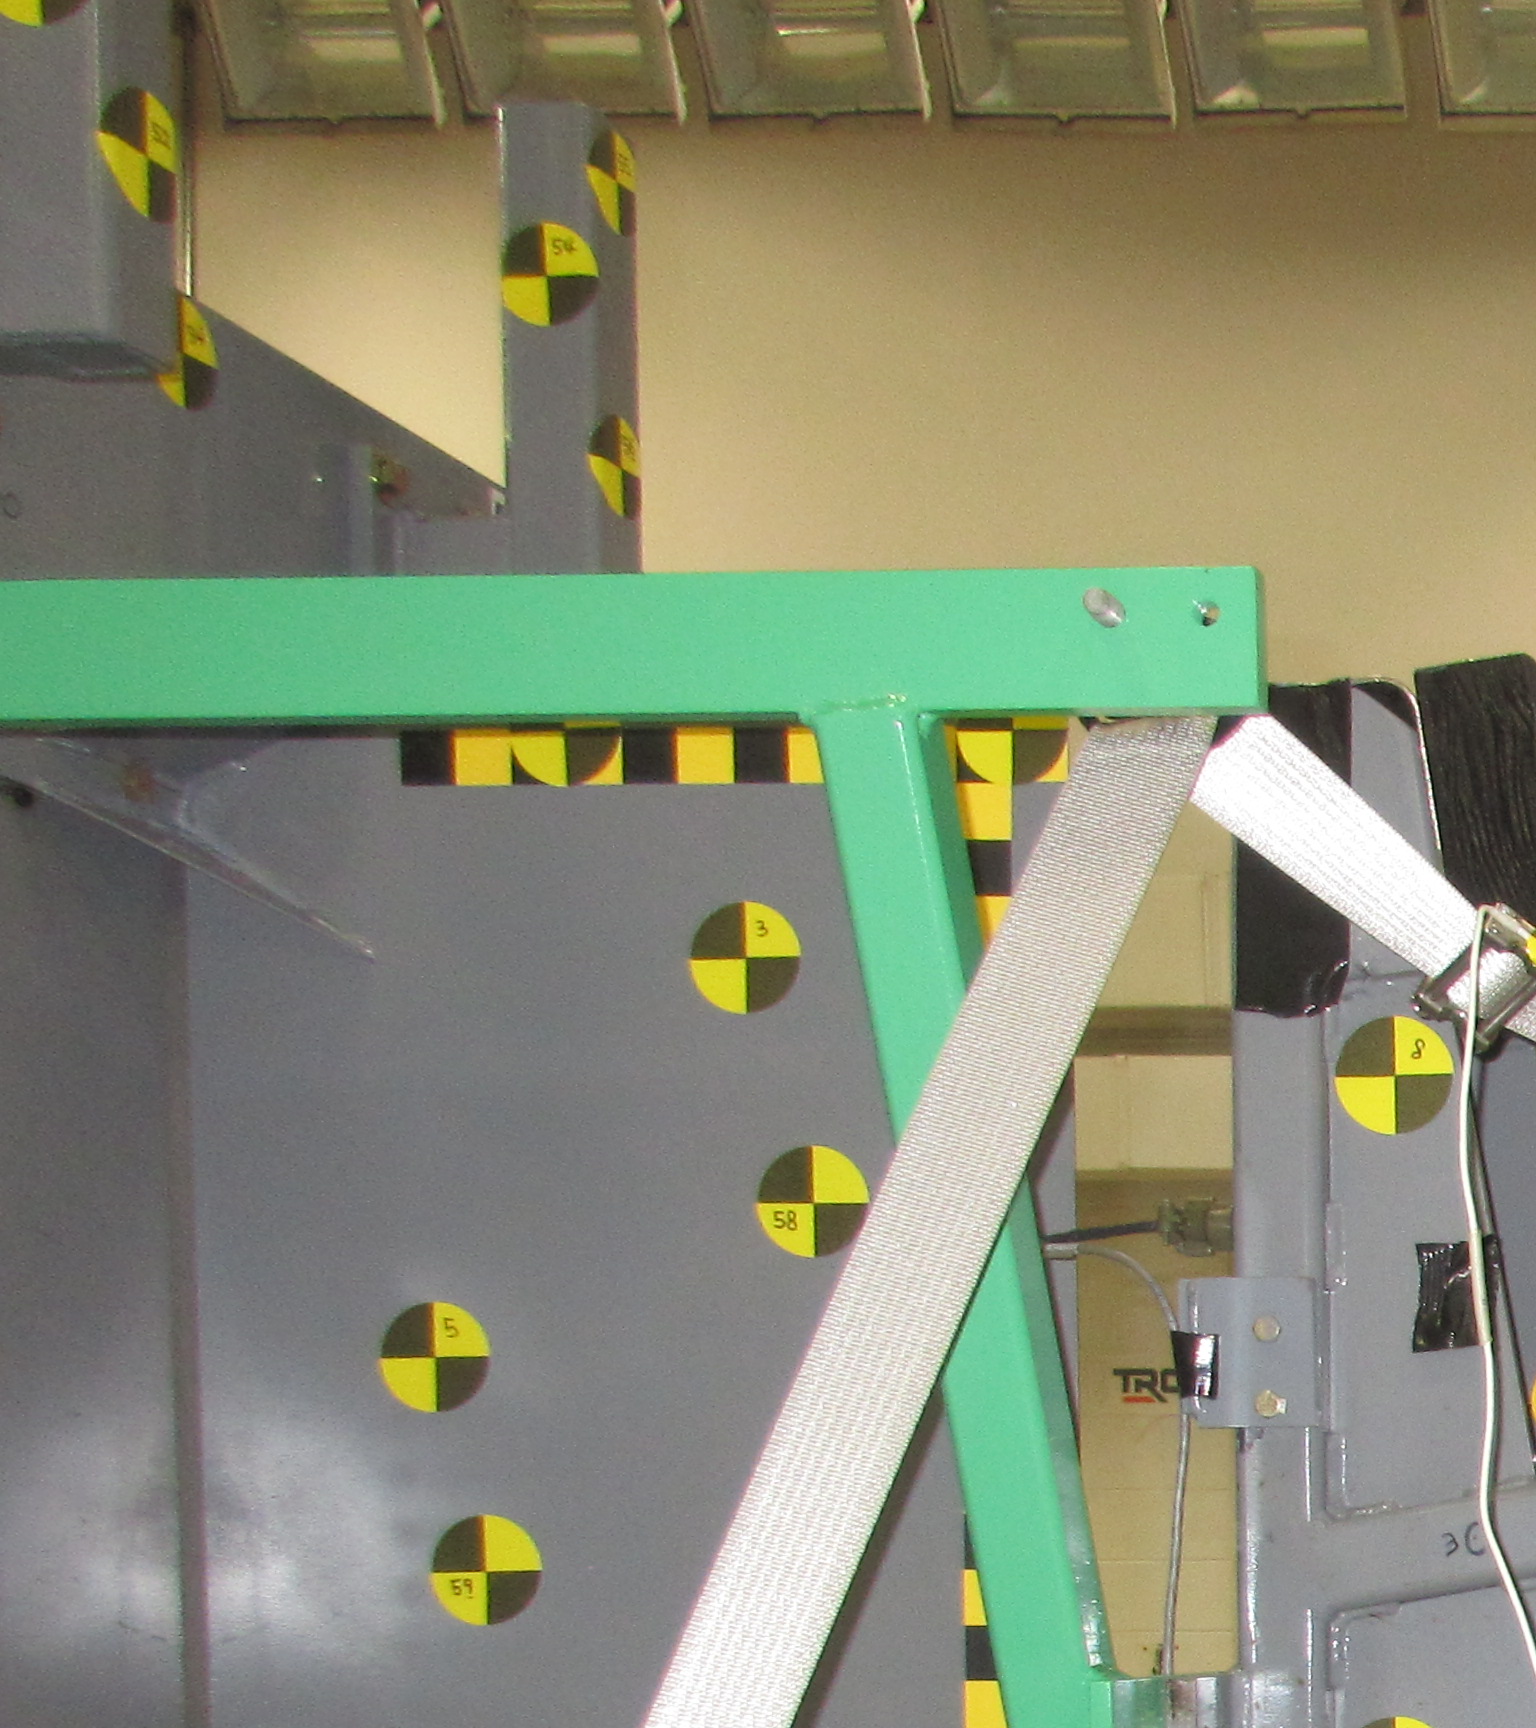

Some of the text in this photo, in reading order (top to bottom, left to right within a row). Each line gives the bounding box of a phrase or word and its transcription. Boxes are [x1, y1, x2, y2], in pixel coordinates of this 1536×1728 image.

[755, 919, 769, 937] 3
[1410, 1038, 1426, 1060] 8
[772, 1210, 798, 1231] 58
[443, 1317, 460, 1338] 5
[449, 1577, 474, 1597] 59
